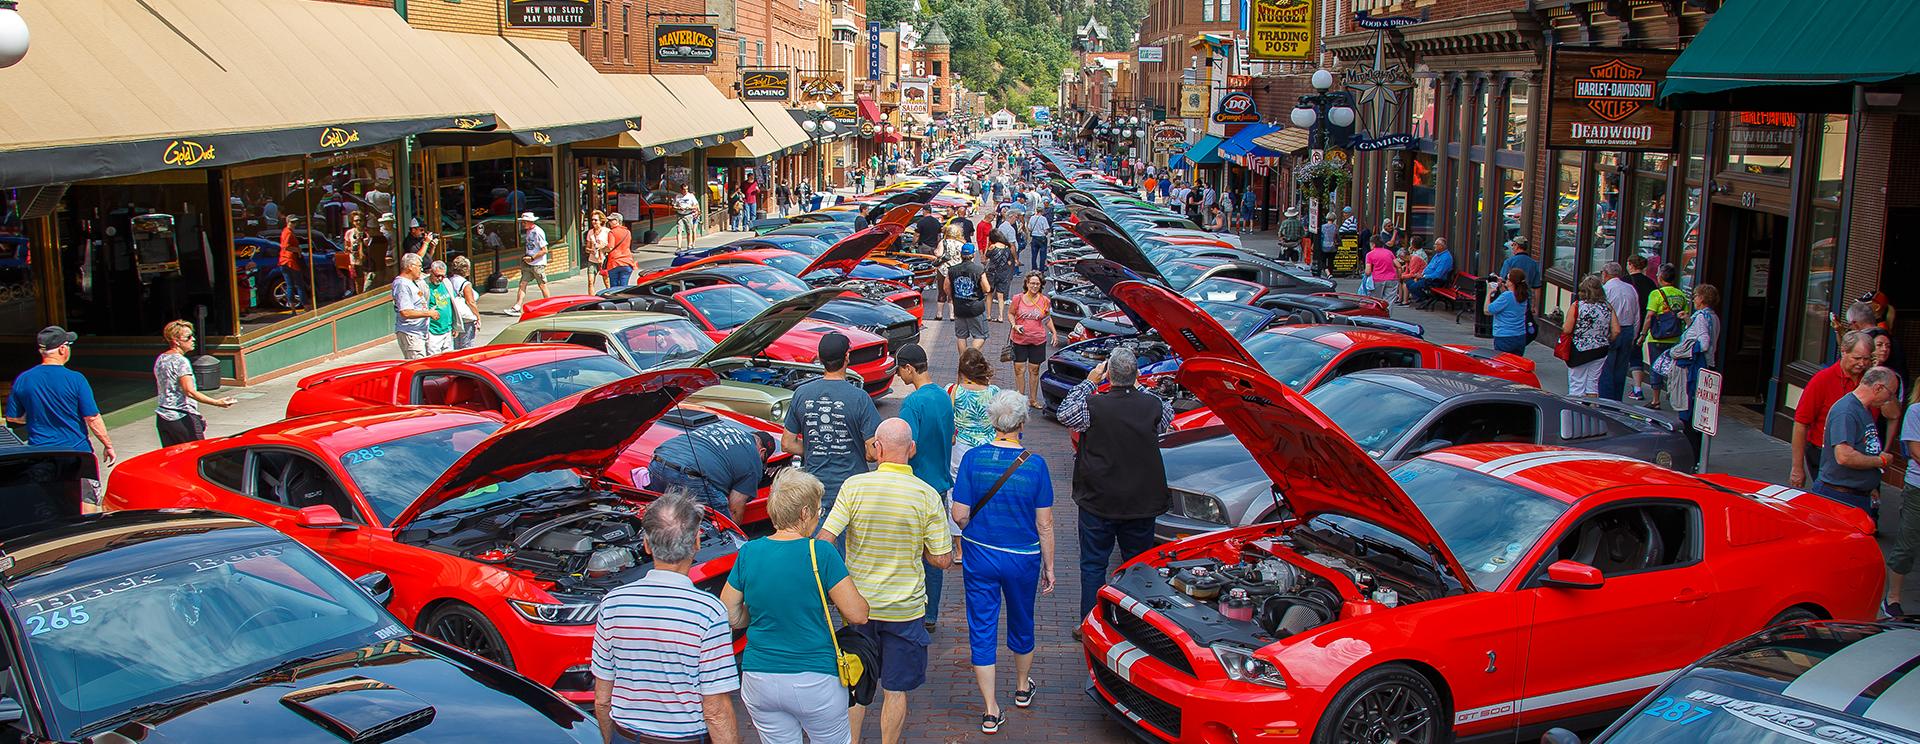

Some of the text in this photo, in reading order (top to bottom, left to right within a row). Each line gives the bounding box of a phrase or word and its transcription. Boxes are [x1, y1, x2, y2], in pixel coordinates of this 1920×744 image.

[525, 6, 584, 14] NEW HOT SLOTS
[1257, 4, 1309, 23] NUGGET
[523, 15, 582, 23] PLAY ROULETTE
[1360, 19, 1382, 27] FOOD
[1382, 19, 1389, 27] &
[658, 30, 715, 48] MAVERICKS
[1258, 31, 1309, 42] TRADING
[1265, 42, 1298, 52] POST
[1596, 63, 1637, 79] MOTOR
[748, 89, 786, 97] GAMING
[1577, 82, 1652, 97] HARLEY-DAVIDSON
[902, 104, 928, 112] SALOON
[1229, 99, 1247, 110] DQ
[1593, 100, 1634, 118] CYCLES
[1570, 123, 1652, 141] DEADWOOD
[1358, 136, 1410, 150] GAMING
[1741, 191, 1756, 208] 681
[505, 371, 534, 384] 278
[1703, 375, 1714, 389] NO
[1696, 386, 1719, 404] PARKING
[346, 445, 385, 464] 285
[31, 573, 164, 615] Black
[26, 605, 90, 636] 265
[1458, 705, 1511, 721] GT 500
[1643, 696, 1713, 725] 287
